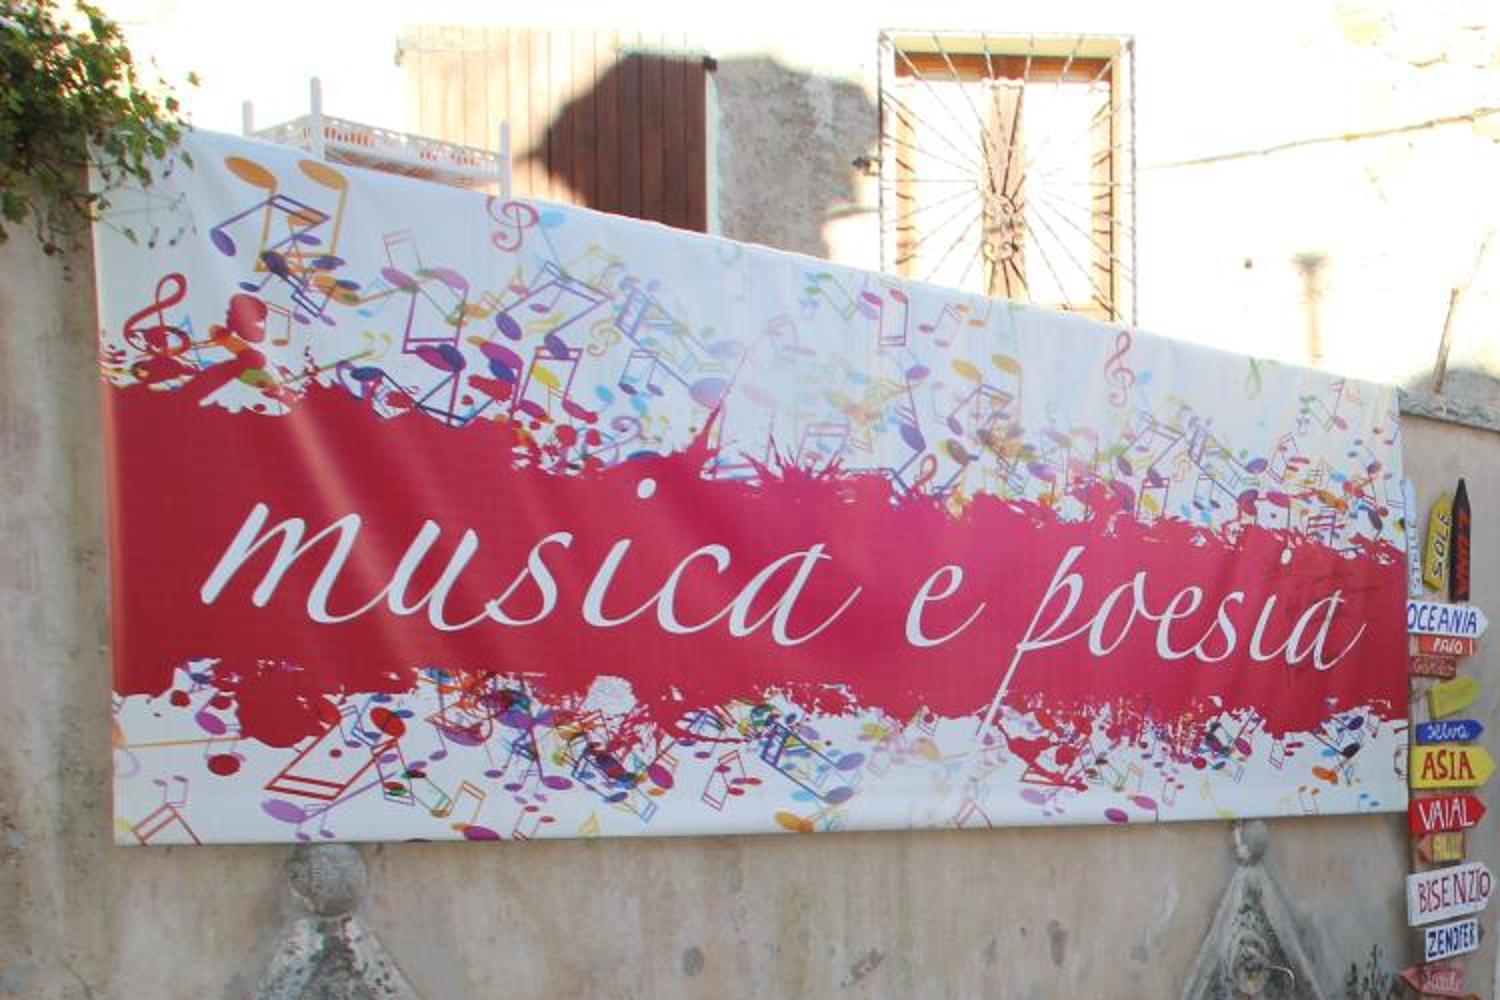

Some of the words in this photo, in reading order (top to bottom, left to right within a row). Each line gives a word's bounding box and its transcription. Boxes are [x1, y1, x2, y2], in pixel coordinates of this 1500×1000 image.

[1433, 512, 1454, 578] SOLE
[201, 477, 861, 650] musica
[906, 562, 987, 649] e
[975, 545, 1368, 737] poesia
[1408, 603, 1478, 635] OCEANIA
[1420, 749, 1475, 782] ASIA
[1417, 869, 1492, 914] BISENZIO
